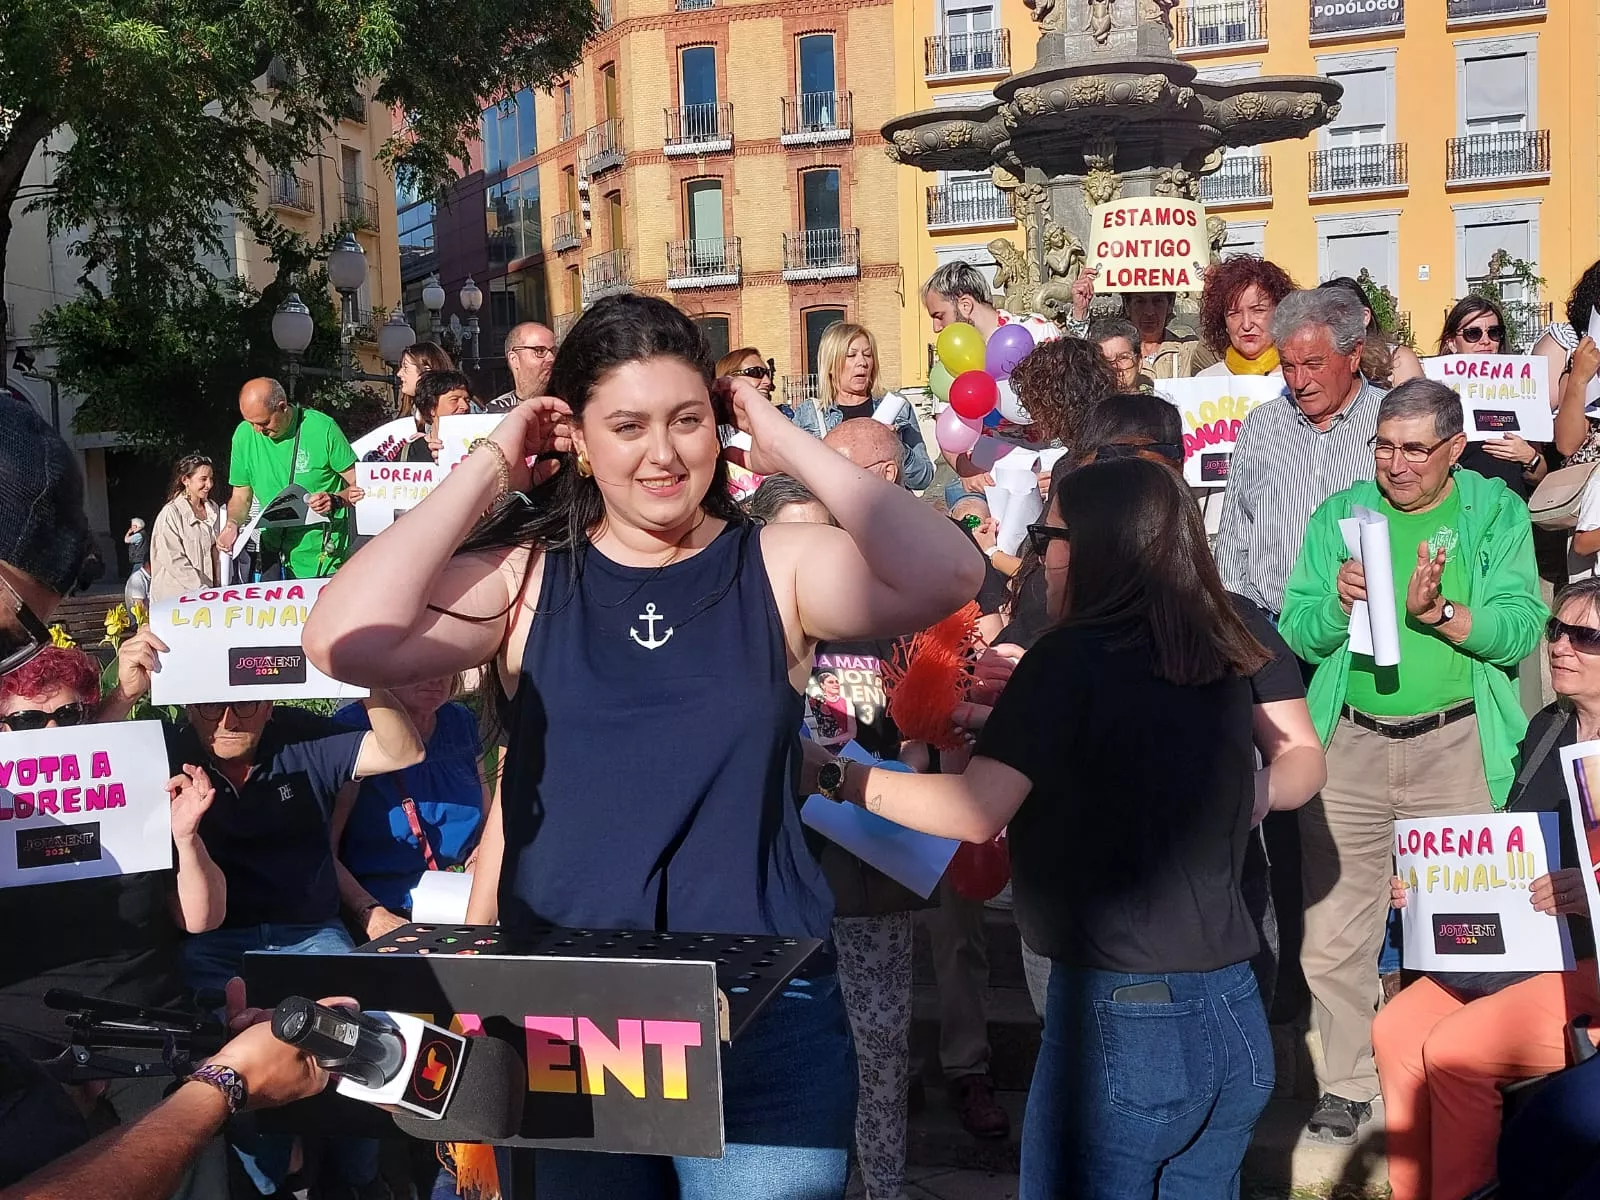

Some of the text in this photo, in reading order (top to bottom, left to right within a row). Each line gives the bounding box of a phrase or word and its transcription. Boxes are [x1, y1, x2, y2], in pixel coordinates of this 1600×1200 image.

[1314, 0, 1399, 18] PODÓLOGO
[1103, 207, 1197, 229] ESTAMOS
[1096, 238, 1191, 258] CONTIGO
[1106, 268, 1190, 287] LORENA
[1444, 360, 1531, 379] LORENA A
[1467, 378, 1537, 400] FINAL!!!
[1184, 395, 1261, 431] LORE
[1183, 419, 1243, 461] ANAD
[370, 467, 433, 483] LORENA
[367, 486, 433, 499] LA FINA
[179, 585, 305, 604] LORENA
[171, 606, 212, 629] LA
[236, 655, 301, 669] JOTALENT
[0, 751, 112, 788] VOTA A
[0, 783, 127, 821] LORENA
[1398, 825, 1525, 858] LORENA A
[45, 846, 71, 857] 2024
[1439, 923, 1497, 937] JOTALENT
[1455, 936, 1478, 945] 2024
[450, 1012, 702, 1100] ENT
